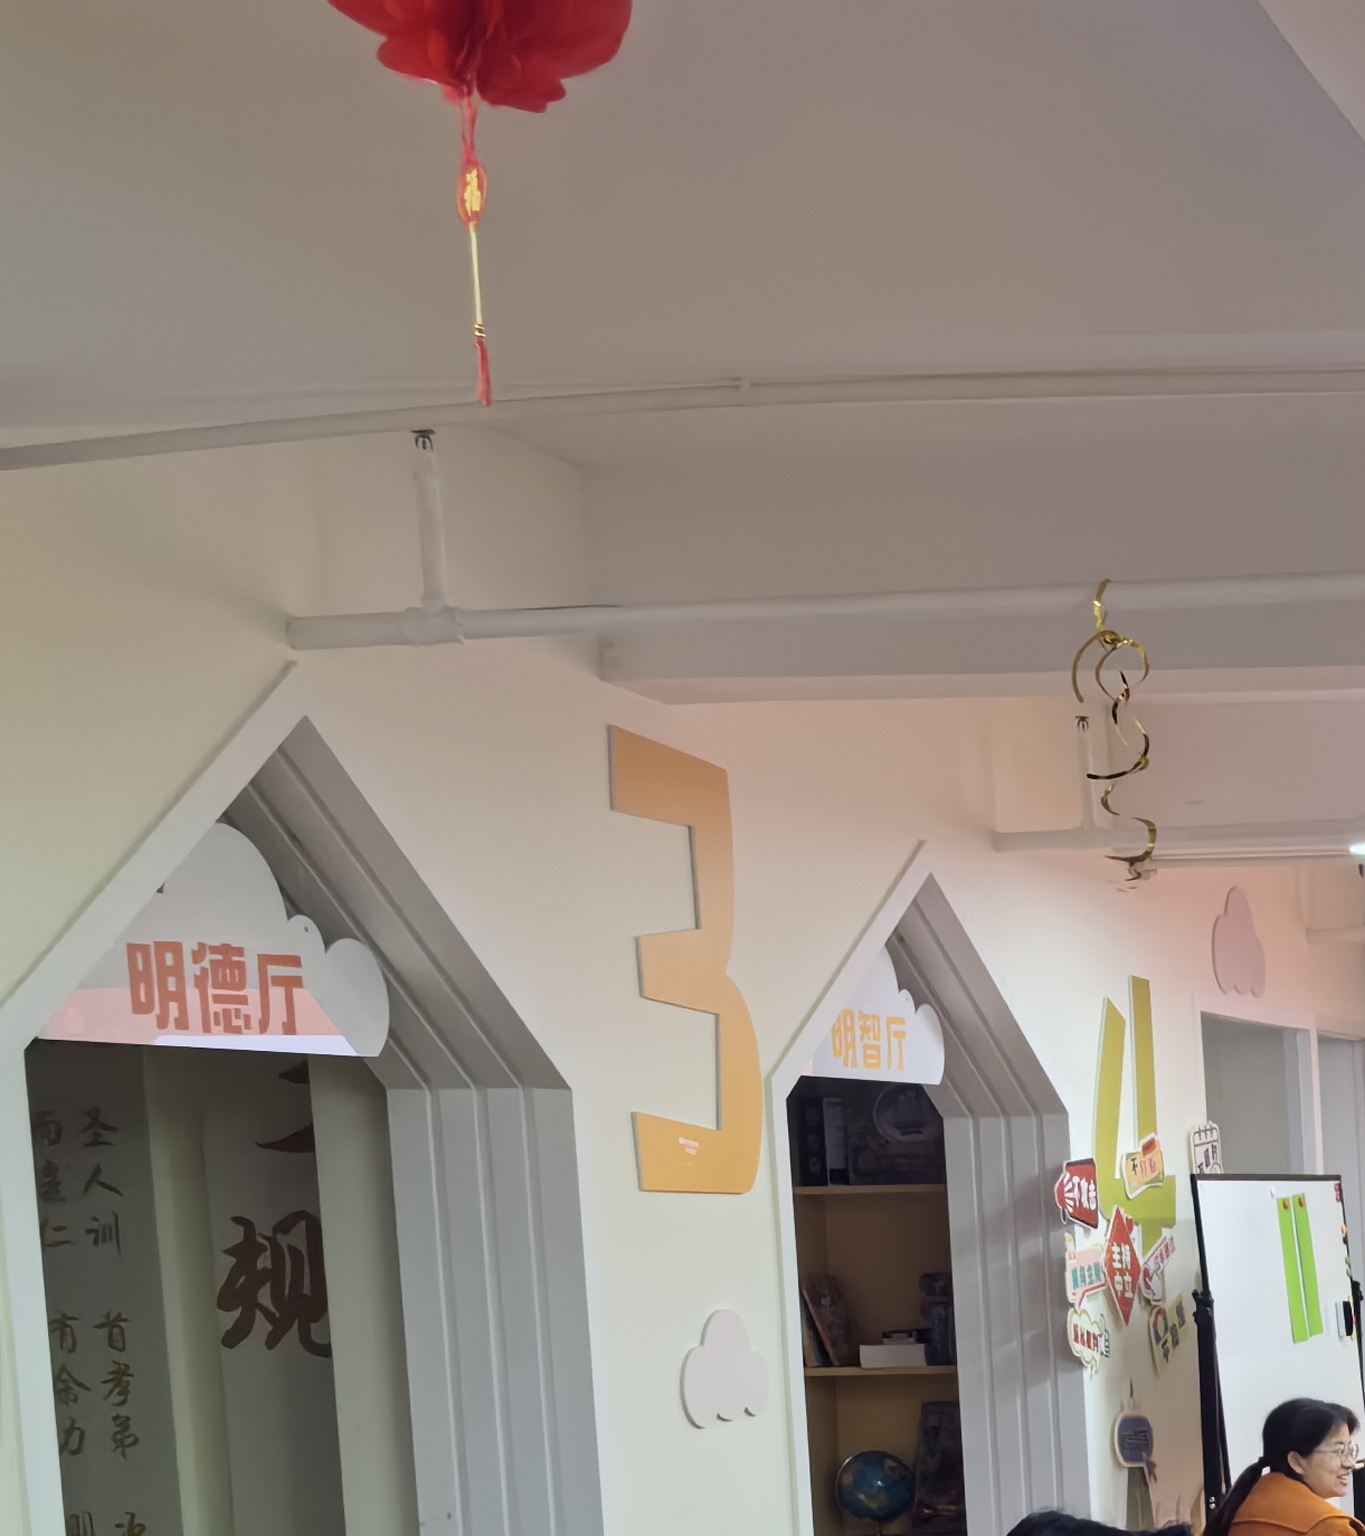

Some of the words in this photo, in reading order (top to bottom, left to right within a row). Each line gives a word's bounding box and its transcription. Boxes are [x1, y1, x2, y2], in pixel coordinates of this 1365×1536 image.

[126, 941, 304, 1036] 明德厅
[831, 1008, 907, 1072] 明智厅
